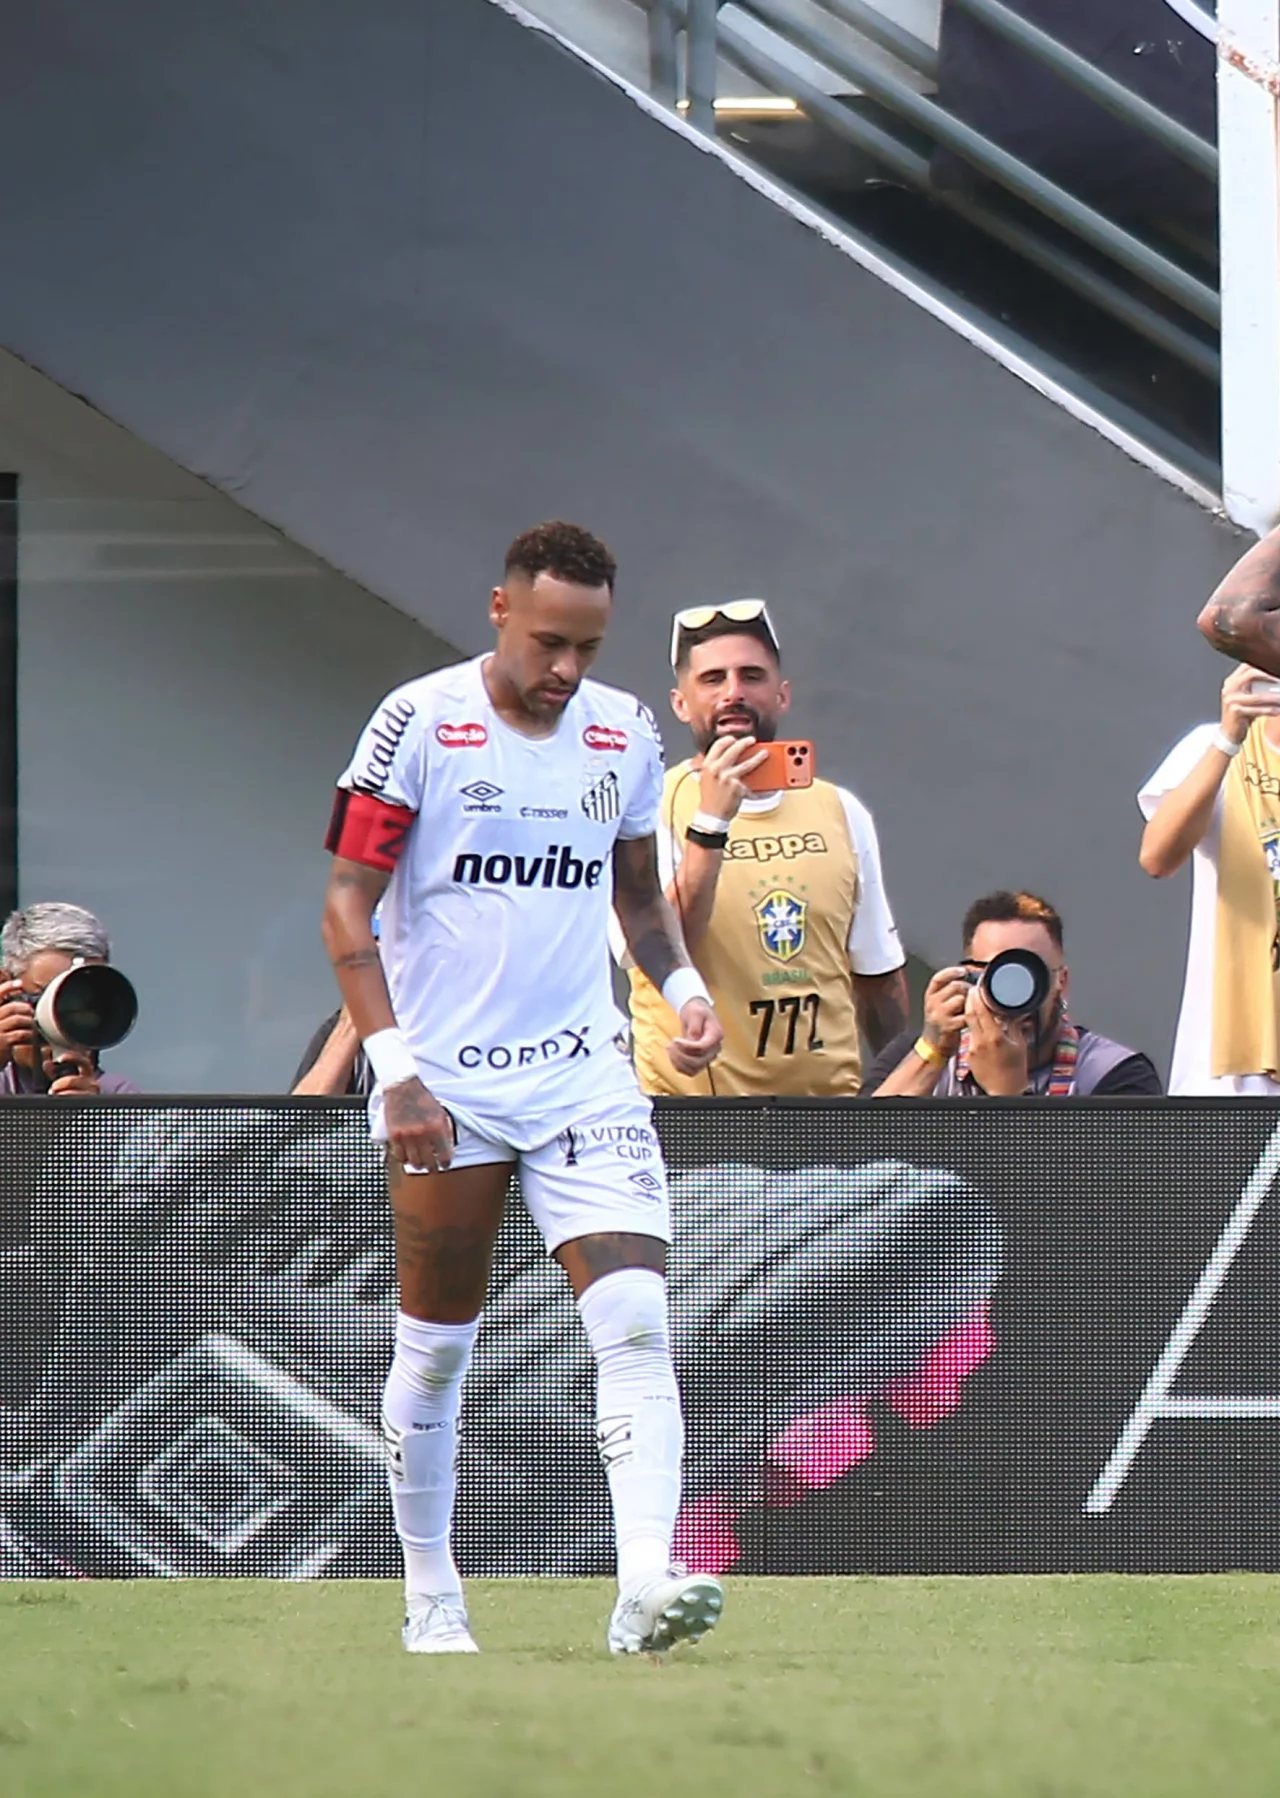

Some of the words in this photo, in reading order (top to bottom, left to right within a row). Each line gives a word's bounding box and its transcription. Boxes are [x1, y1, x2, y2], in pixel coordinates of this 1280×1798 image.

[453, 844, 604, 889] novibe
[590, 1124, 657, 1147] VITÓR
[616, 1144, 652, 1161] CUP
